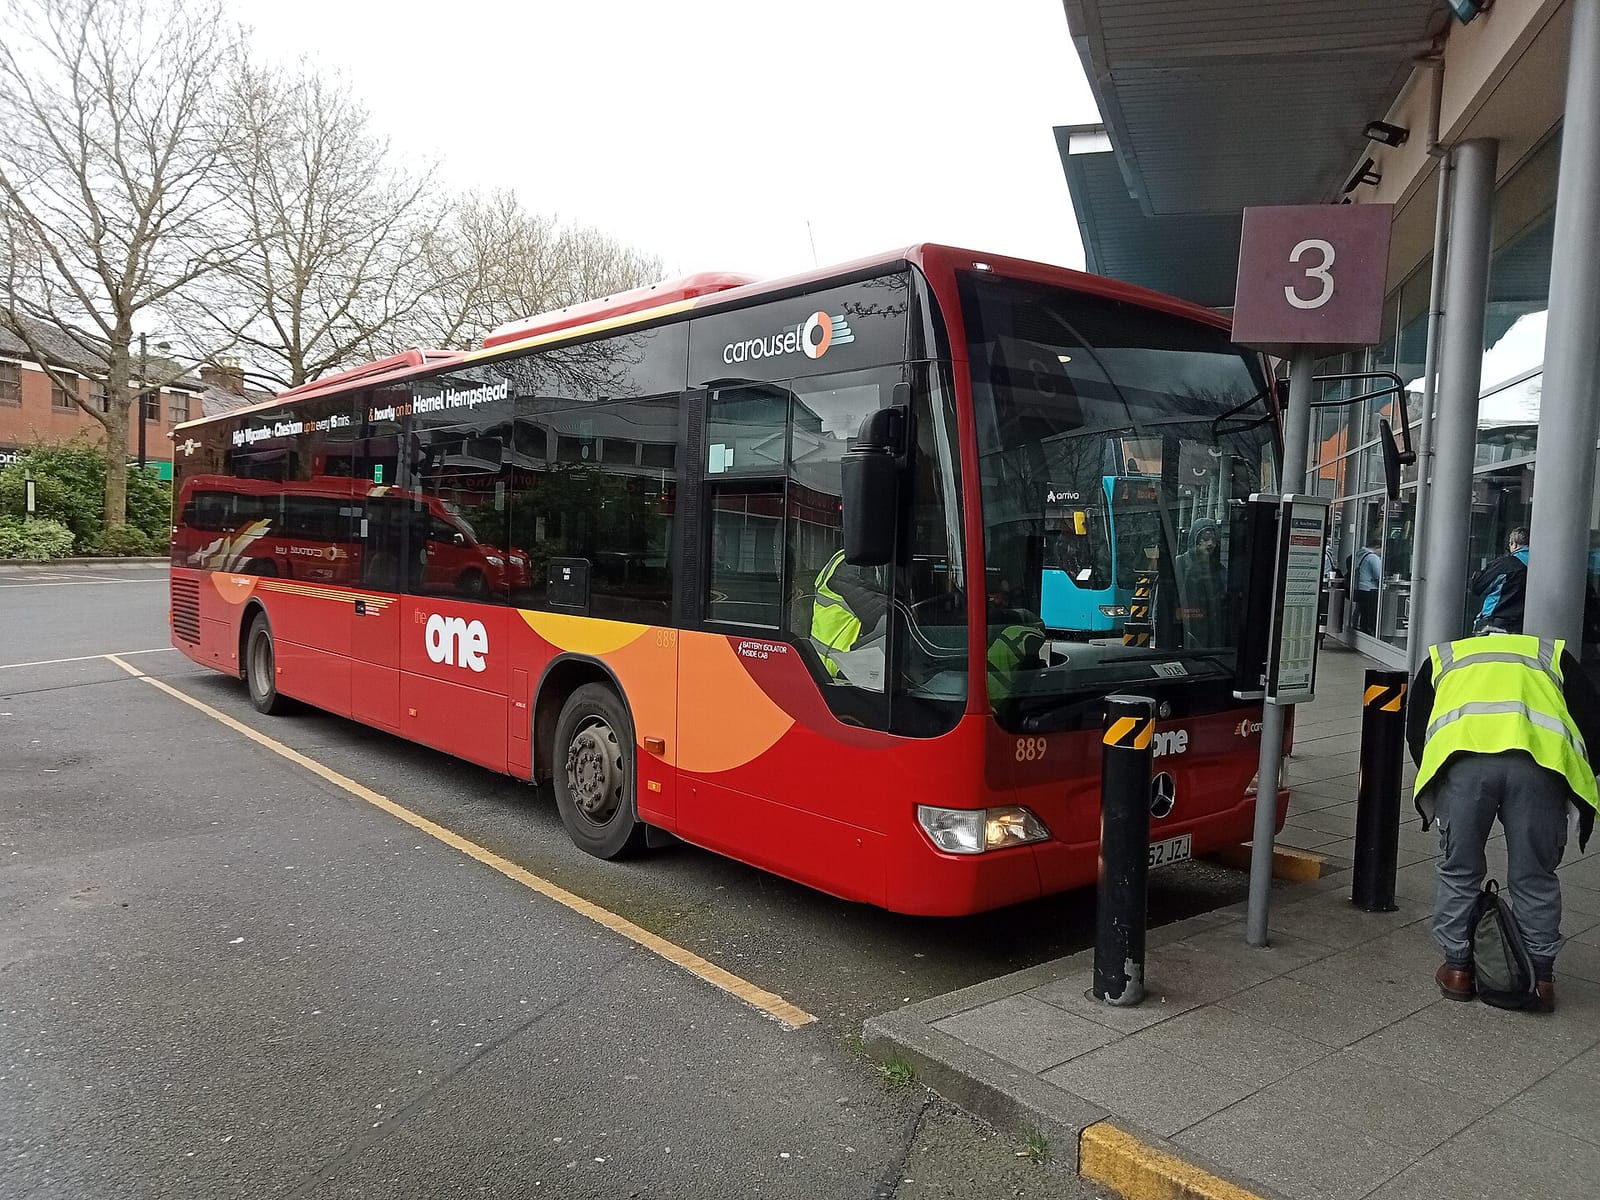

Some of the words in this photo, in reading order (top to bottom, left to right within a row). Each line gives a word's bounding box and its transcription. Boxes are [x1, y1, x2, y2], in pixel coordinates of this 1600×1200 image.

[1284, 239, 1336, 310] 3
[723, 323, 801, 364] carousel
[374, 404, 395, 421] hourly
[395, 404, 405, 417] on
[404, 402, 412, 415] to
[412, 391, 444, 415] Hemel
[445, 377, 509, 410] Hempstead
[232, 429, 245, 447] High
[244, 424, 272, 445] Wycombe
[274, 419, 303, 437] Chesham
[316, 417, 330, 432] every
[414, 607, 427, 625] the
[425, 613, 489, 673] one
[656, 629, 678, 649] 889
[742, 640, 763, 651] BATTERY
[763, 643, 788, 654] ISOLATOR
[742, 648, 758, 658] INSIDE
[757, 651, 769, 660] CAB
[1015, 736, 1047, 761] 889
[1167, 837, 1190, 862] JZJ
